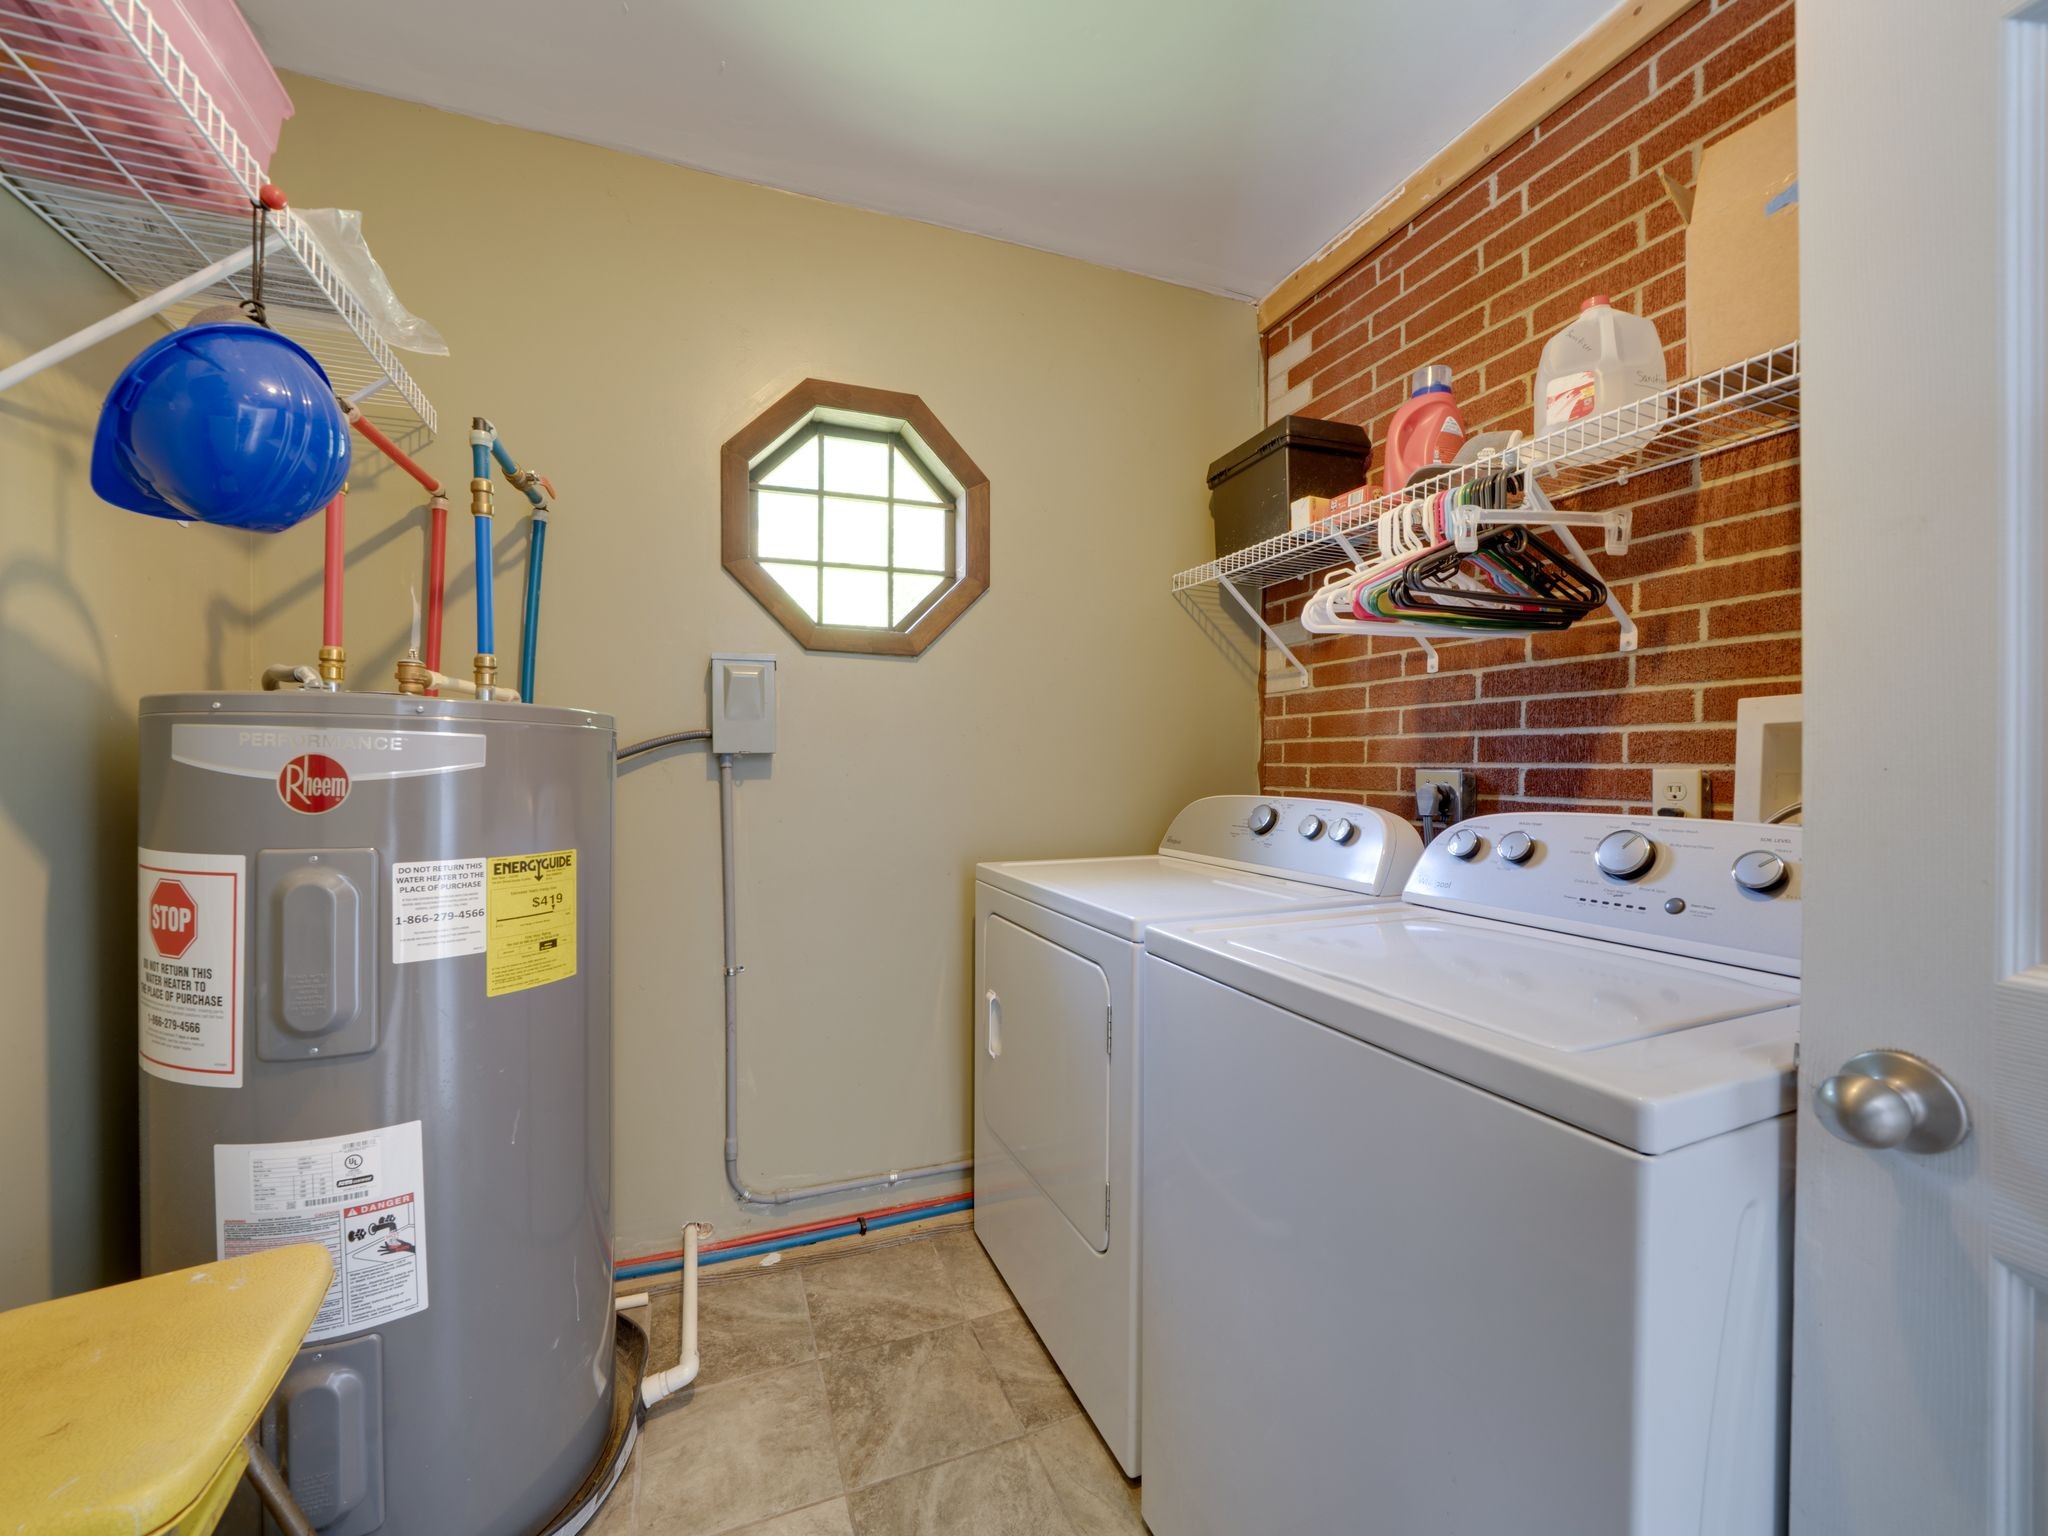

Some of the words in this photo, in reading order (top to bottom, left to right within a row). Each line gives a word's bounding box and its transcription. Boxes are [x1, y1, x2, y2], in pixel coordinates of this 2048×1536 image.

[239, 732, 404, 751] PERFORMANCE
[286, 754, 347, 805] Rheem
[398, 867, 411, 875] DO
[413, 865, 431, 874] NOT
[432, 864, 464, 872] RETURN
[465, 862, 483, 870] THIS
[493, 855, 572, 877] ENERGYGUIDE
[395, 876, 425, 884] WATER
[426, 873, 457, 882] HEATER
[458, 872, 469, 880] TO
[399, 885, 426, 893] PLACE
[440, 881, 481, 890] PURCHASE
[152, 903, 192, 933] STOP
[395, 908, 485, 926] 1-866-279-4566
[150, 961, 159, 973] NOT
[161, 963, 190, 978] RETURN
[191, 967, 213, 980] THIS
[145, 972, 162, 987] WATER
[163, 976, 192, 991] HEATER
[194, 981, 206, 993] TO
[147, 985, 164, 1000] PLACE
[165, 990, 174, 1002] OF
[176, 992, 223, 1007] PURCHASE
[147, 1013, 201, 1033] 1-866-279-4566
[360, 1195, 410, 1213] DANGER
